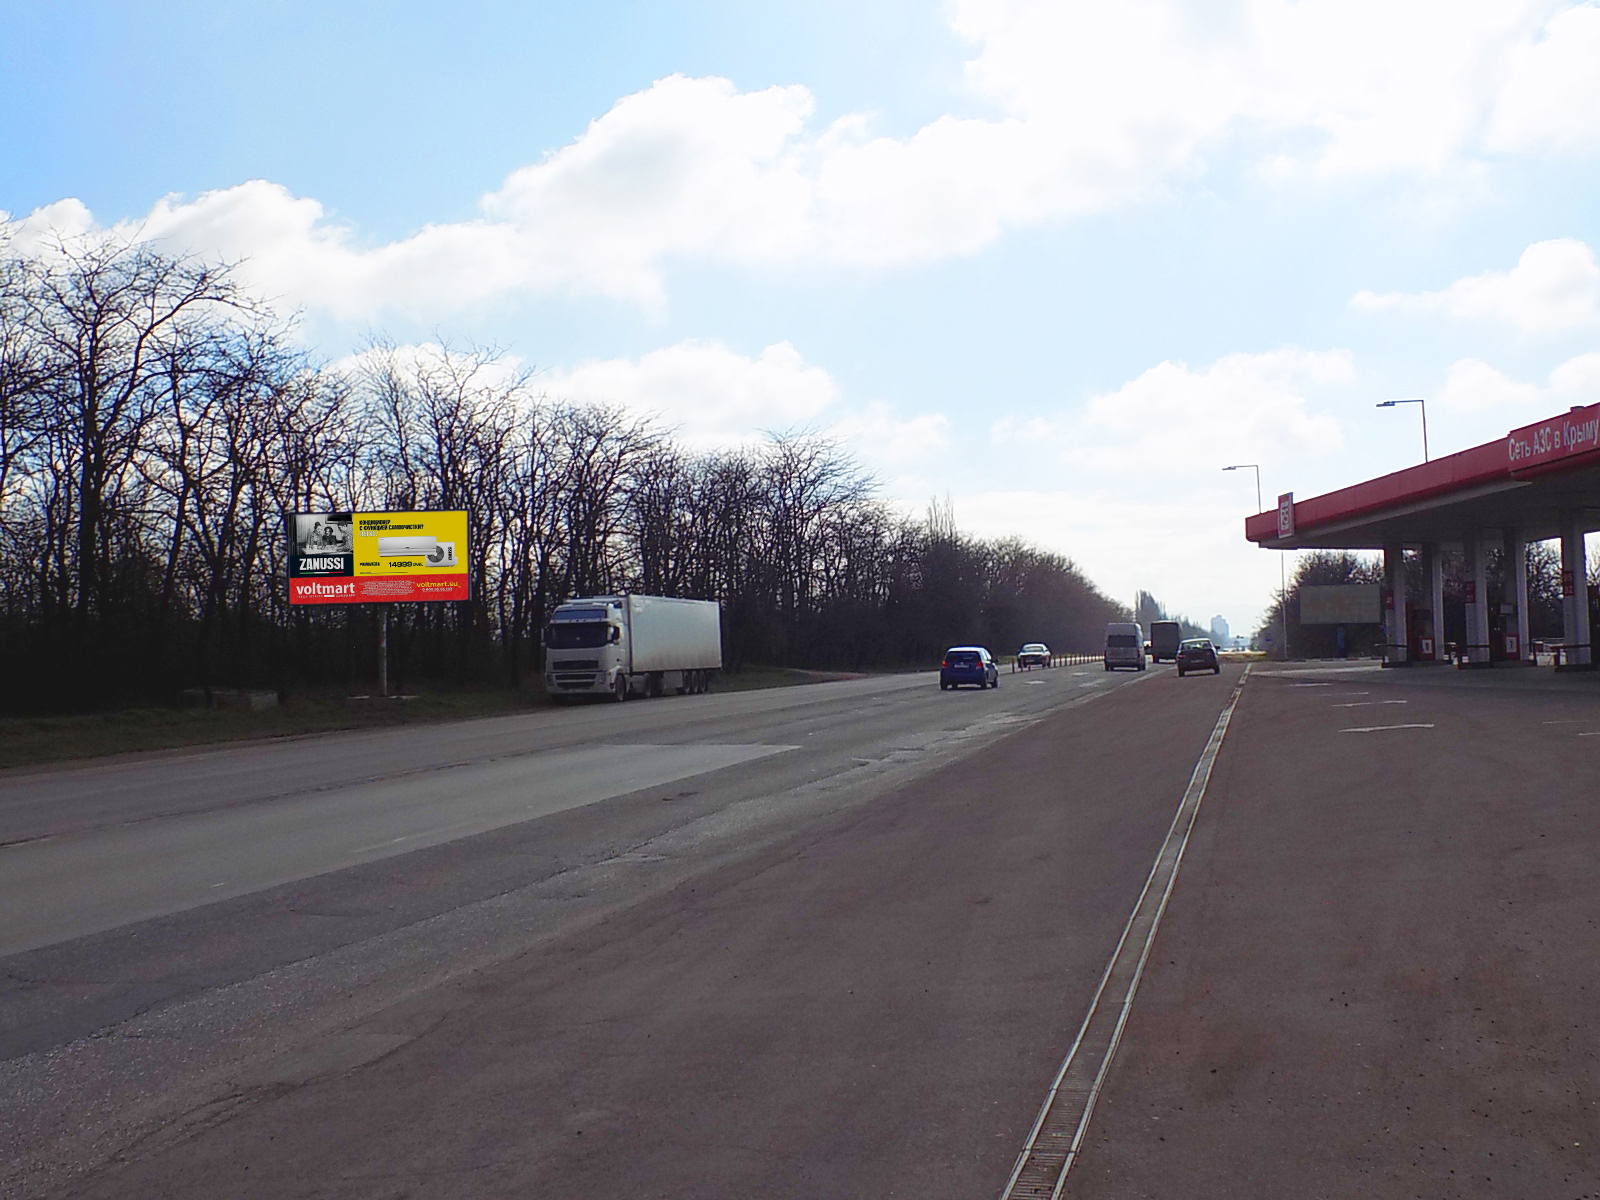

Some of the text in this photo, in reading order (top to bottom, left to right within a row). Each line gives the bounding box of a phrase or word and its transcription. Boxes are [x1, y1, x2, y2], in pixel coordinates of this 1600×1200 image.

[1508, 418, 1599, 461] Сеть АЗС в Крыму
[299, 557, 344, 571] ZANUSSI
[296, 582, 355, 595] voltmart
